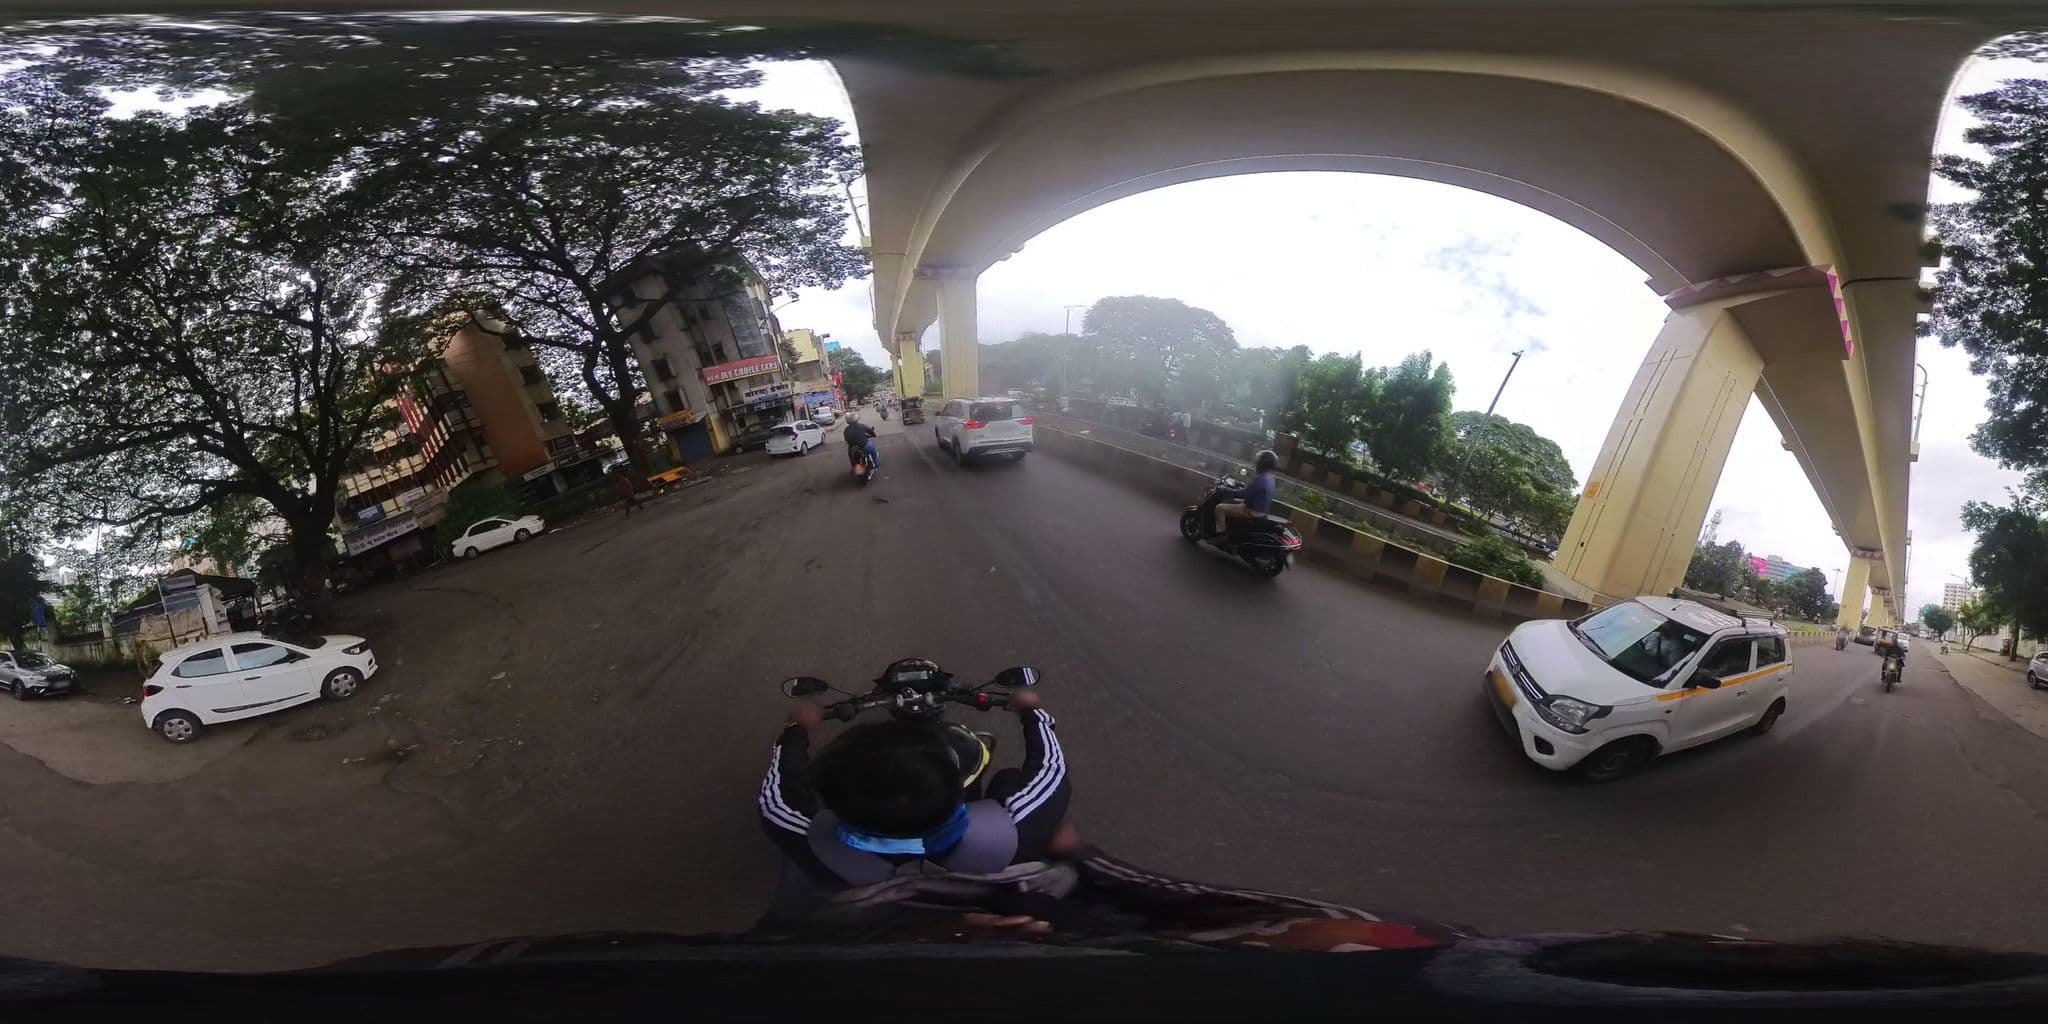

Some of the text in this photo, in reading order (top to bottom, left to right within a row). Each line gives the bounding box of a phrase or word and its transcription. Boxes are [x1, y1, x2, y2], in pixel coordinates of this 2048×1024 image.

[720, 370, 733, 380] MY
[734, 365, 760, 376] CHOICE
[761, 362, 778, 371] CARS
